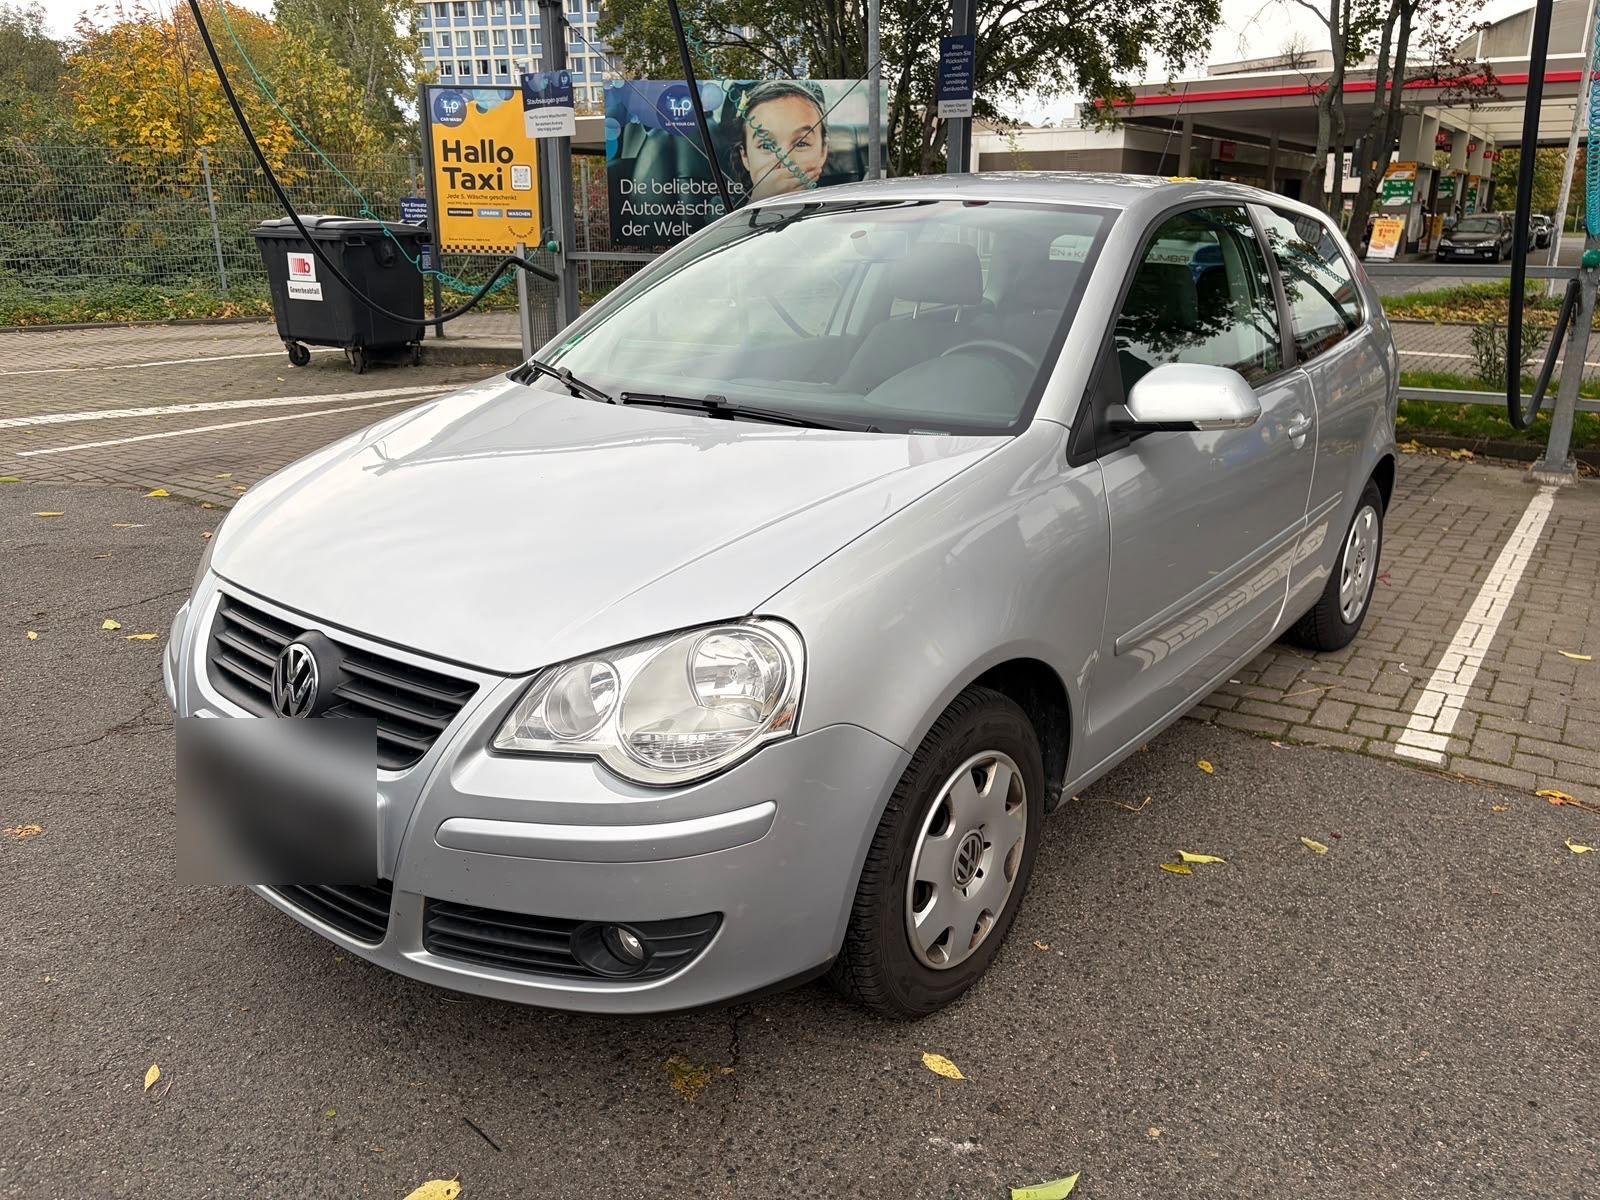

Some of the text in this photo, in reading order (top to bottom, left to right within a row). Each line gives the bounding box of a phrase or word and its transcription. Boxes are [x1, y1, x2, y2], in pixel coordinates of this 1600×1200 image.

[442, 139, 514, 164] Hallo
[442, 166, 503, 190] Taxi
[620, 178, 743, 194] Die beliebtete
[620, 199, 725, 215] Autowäsche
[622, 220, 650, 236] der
[289, 285, 321, 295] Gewerbeabfall
